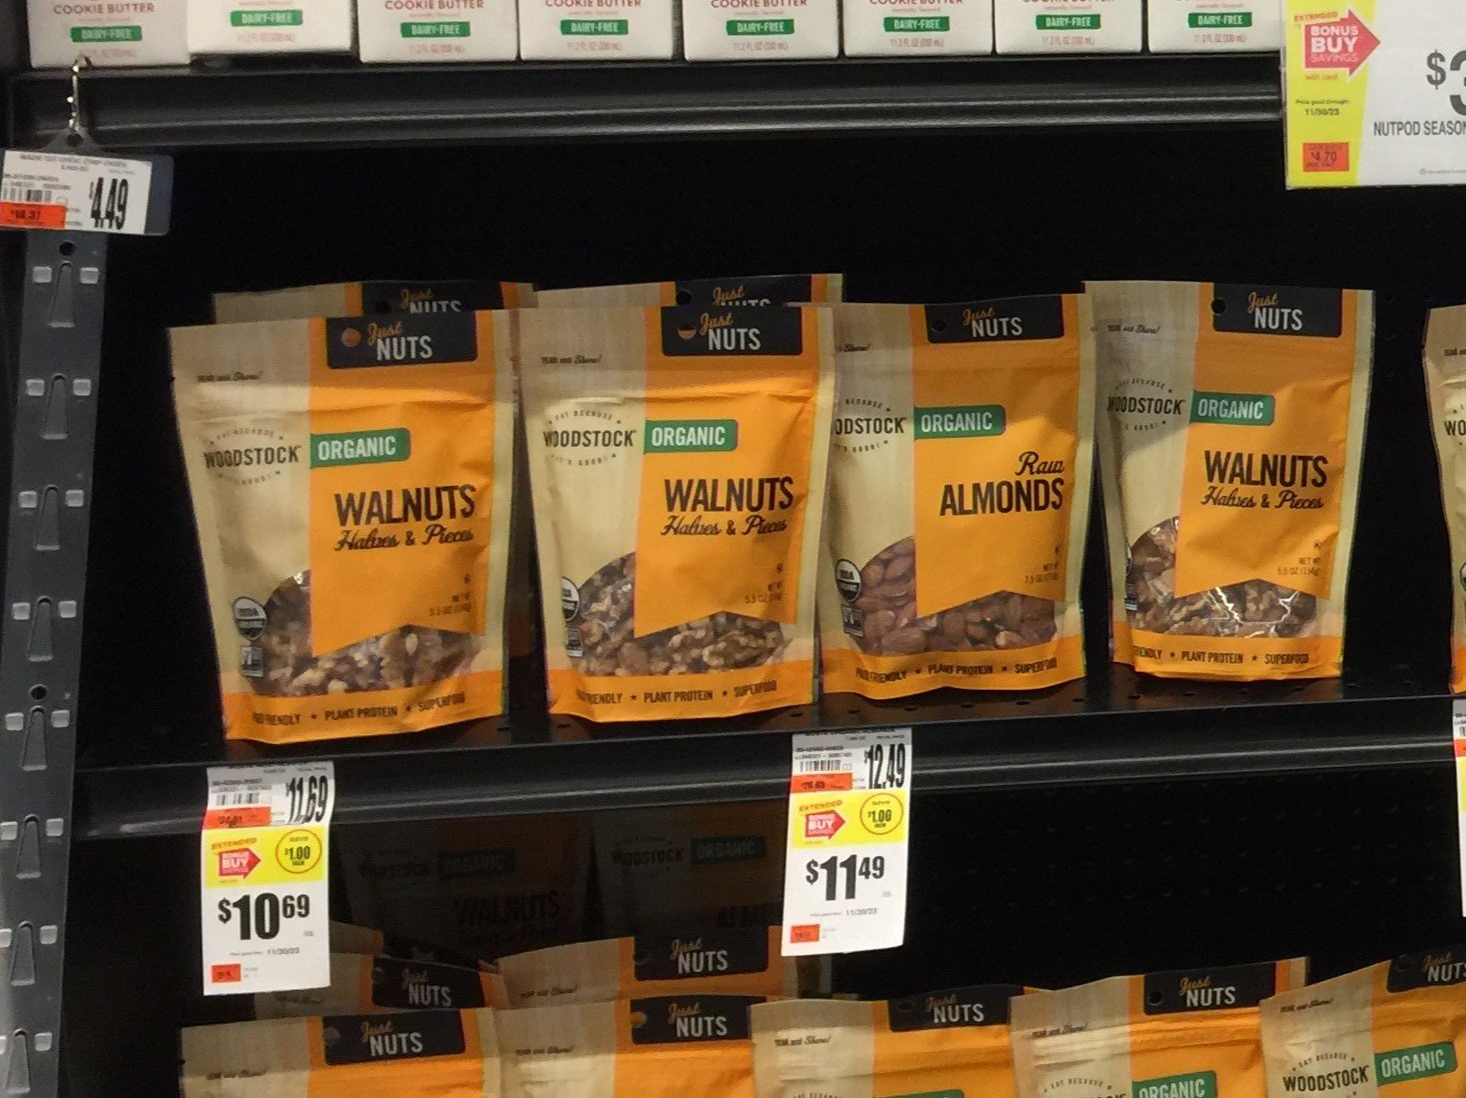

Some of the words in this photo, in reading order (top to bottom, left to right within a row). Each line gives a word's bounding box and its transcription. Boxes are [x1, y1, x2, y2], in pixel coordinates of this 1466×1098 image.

[737, 22, 784, 32] DAIRY-FREE
[1310, 26, 1359, 36] BONUS
[1310, 37, 1358, 53] BUY
[1310, 53, 1358, 62] SAVINGS
[1374, 121, 1421, 136] NUTPOD
[971, 317, 1023, 338] NUTS
[1254, 308, 1303, 331] NUTS
[376, 335, 433, 361] NUTS
[708, 328, 761, 351] NUTS
[1107, 396, 1185, 415] WOODSTOCK
[1198, 398, 1264, 419] ORGANIC
[921, 412, 992, 433] ORGANIC
[651, 427, 725, 447] ORGANIC
[204, 446, 300, 469] WOODSTOCK
[318, 435, 396, 461] ORGANIC
[1015, 451, 1064, 476] Raw
[1204, 450, 1328, 488] WALNUTS
[335, 485, 476, 527] WALNUTS
[664, 477, 794, 512] WALNUTS
[939, 478, 1064, 516] ALMONDS
[1201, 485, 1256, 508] Halves
[1260, 493, 1270, 508] &
[1275, 490, 1324, 510] Pieces
[677, 951, 728, 973] NUTS
[1185, 987, 1236, 1007] NUTS
[1283, 1066, 1369, 1092] WOODSTOCK
[1381, 1049, 1446, 1077] ORGANIC
